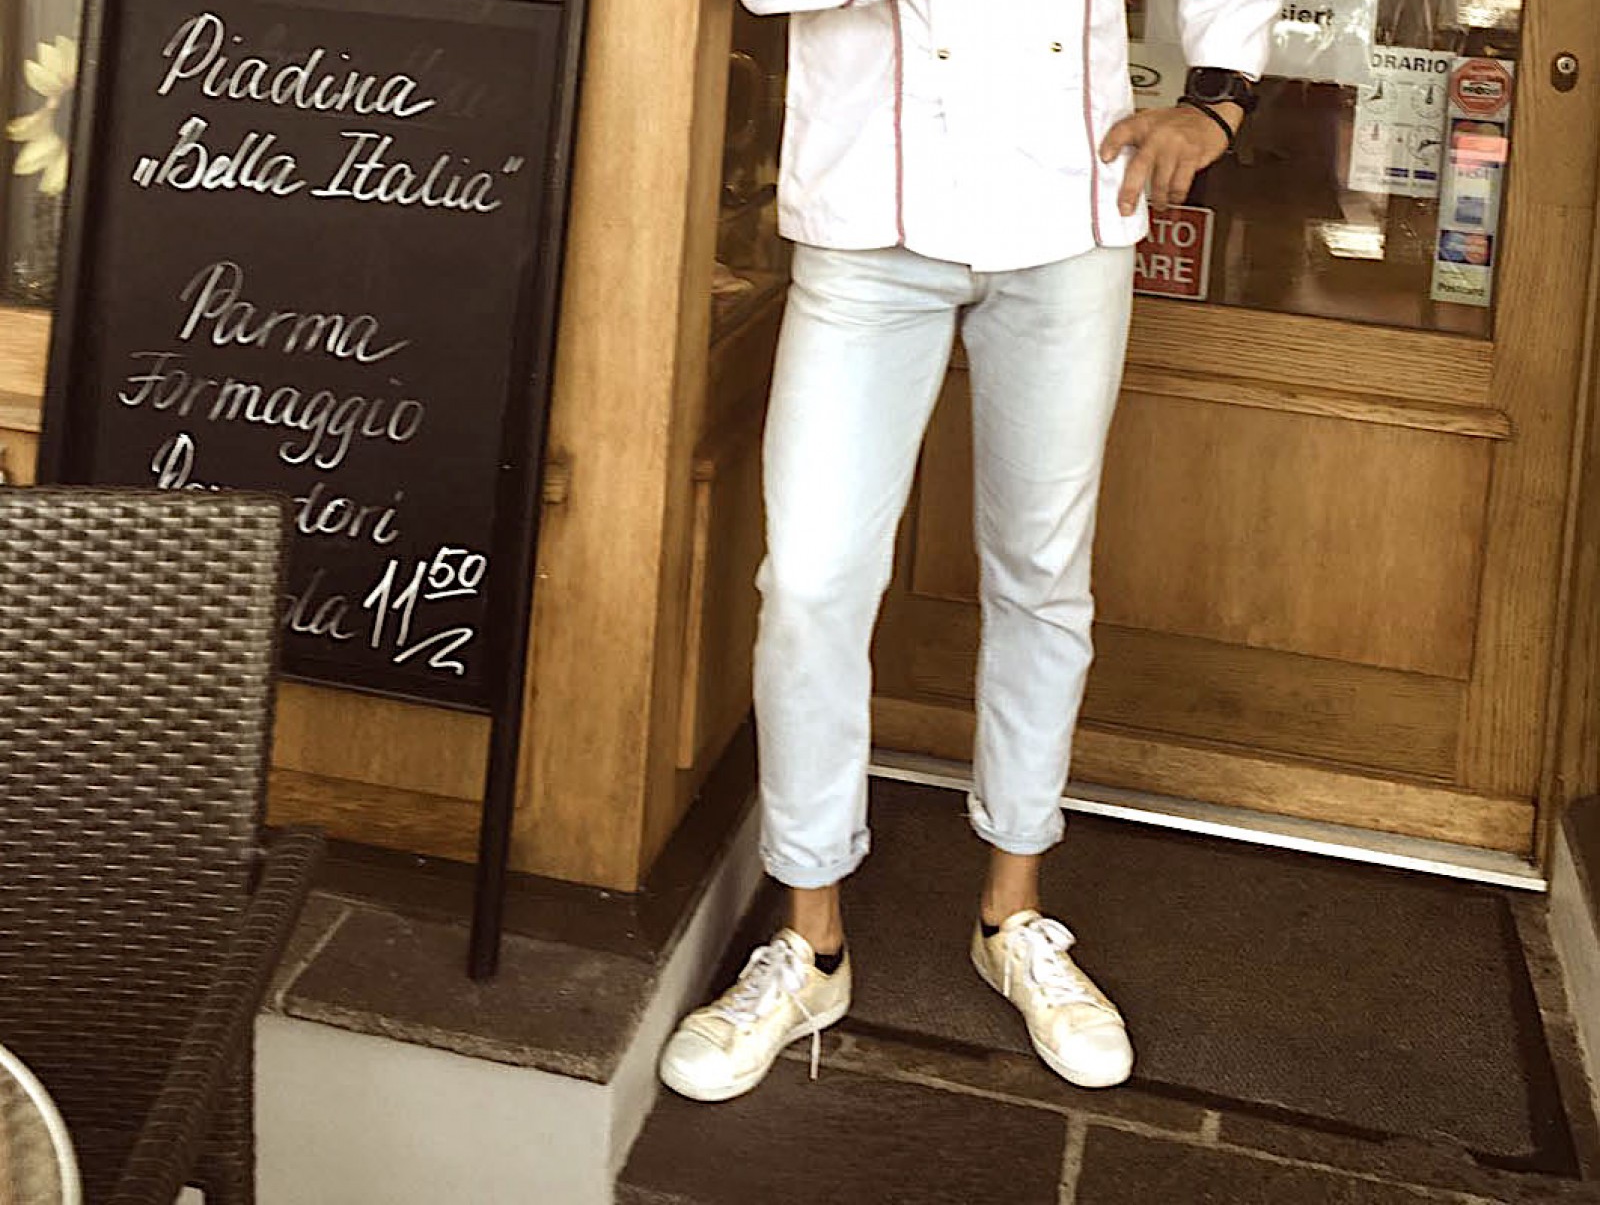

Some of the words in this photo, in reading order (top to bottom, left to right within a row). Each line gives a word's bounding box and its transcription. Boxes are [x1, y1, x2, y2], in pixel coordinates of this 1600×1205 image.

[1281, 4, 1335, 26] siert
[157, 12, 437, 118] Piadina
[1371, 53, 1448, 74] ORARIO
[1146, 219, 1197, 247] TO
[1134, 253, 1194, 283] ARE
[179, 261, 411, 362] Parma
[118, 350, 425, 470] Formaggio
